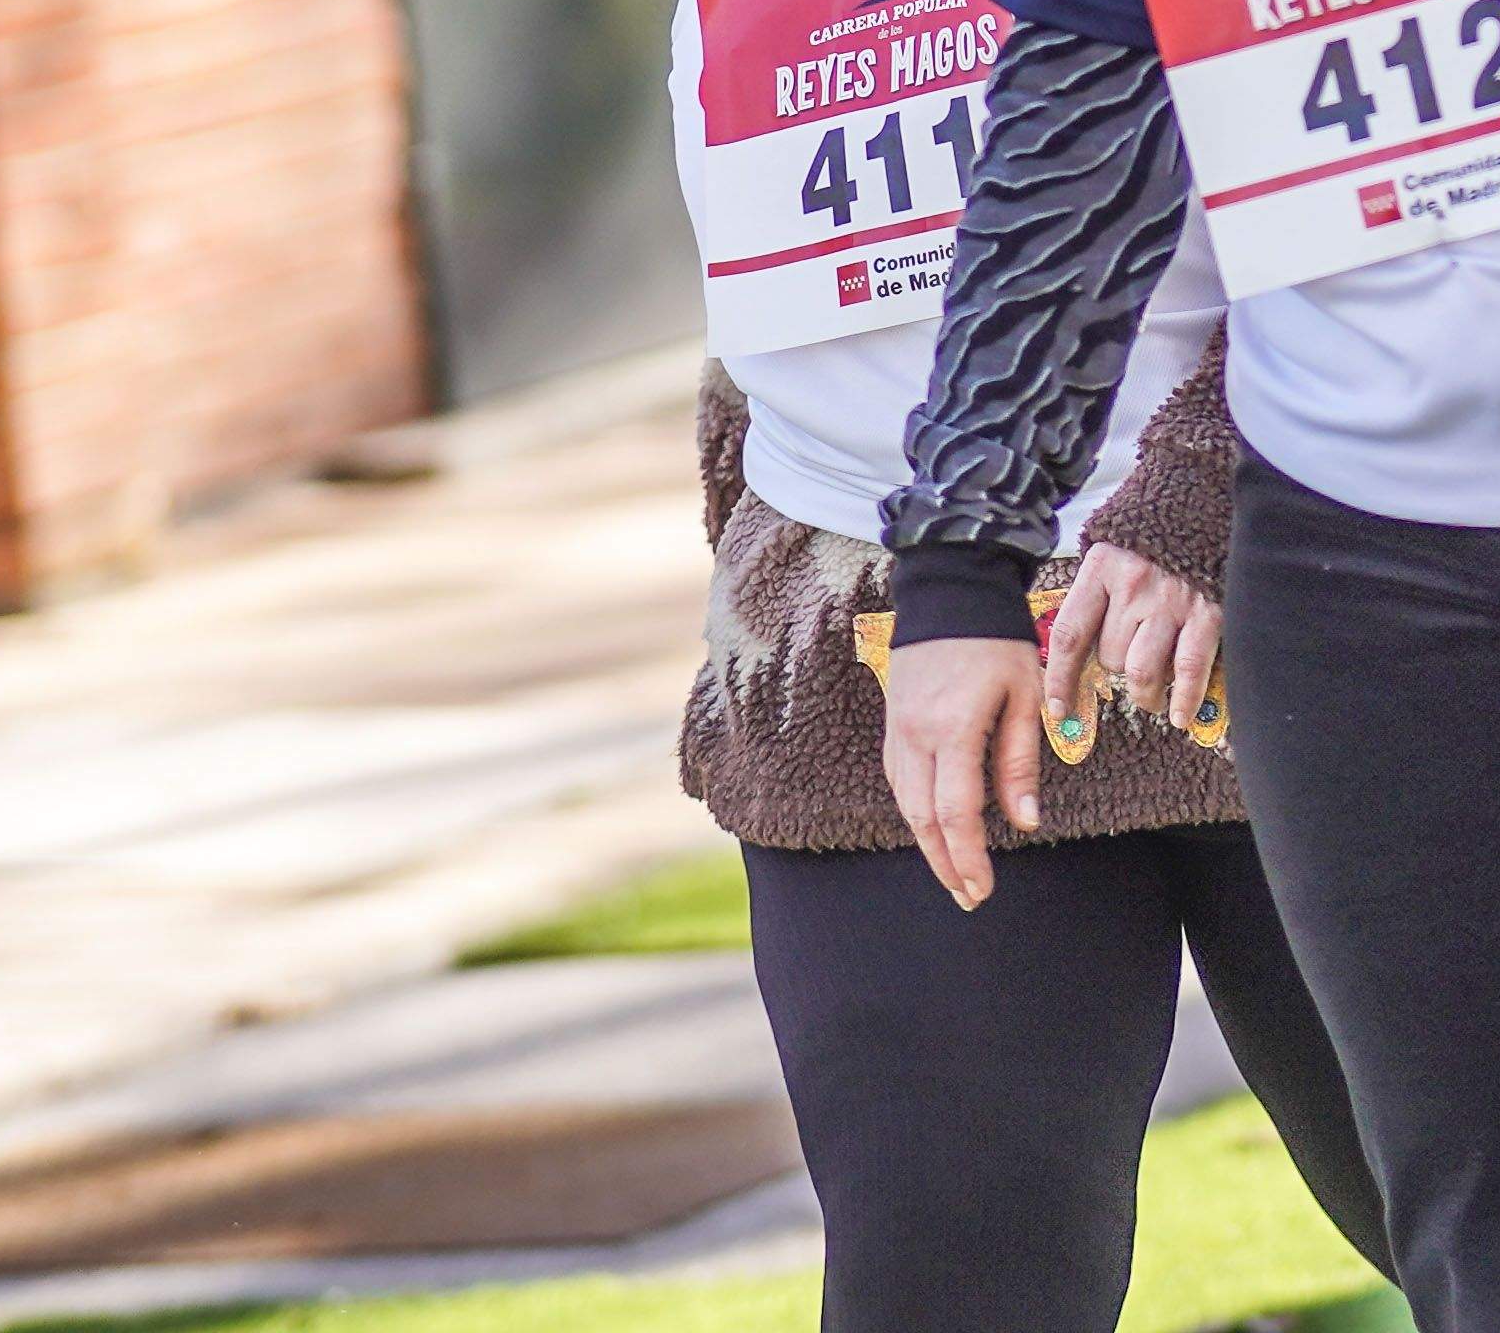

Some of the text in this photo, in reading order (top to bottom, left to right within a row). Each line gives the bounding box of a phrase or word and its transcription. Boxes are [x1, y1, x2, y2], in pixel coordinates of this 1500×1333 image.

[809, 9, 890, 46] CARRERA
[775, 13, 999, 118] REYES MAGOS
[801, 95, 976, 227] 411
[873, 242, 955, 274] Comunid
[876, 279, 903, 298] de
